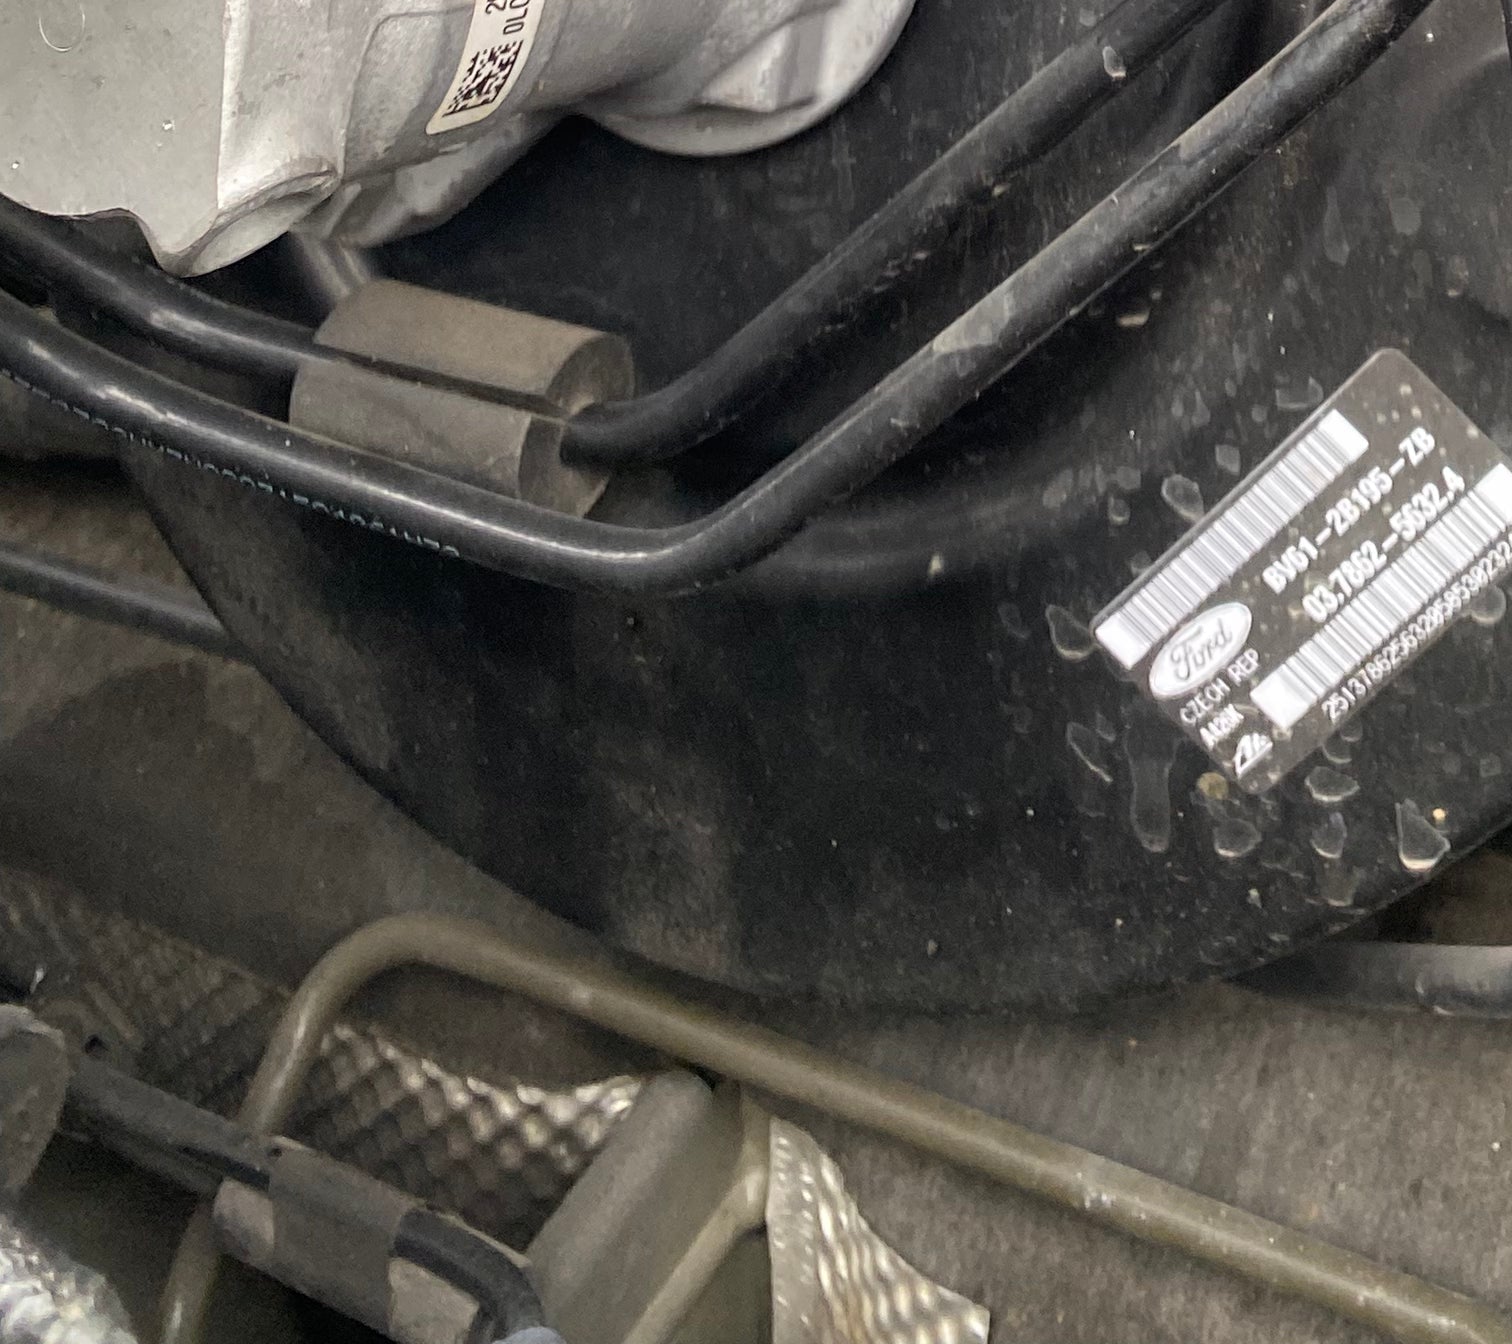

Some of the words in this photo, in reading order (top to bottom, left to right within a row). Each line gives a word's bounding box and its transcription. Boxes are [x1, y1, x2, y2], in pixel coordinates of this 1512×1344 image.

[1262, 426, 1436, 595] BV61-2B195-ZB
[1301, 465, 1466, 623] 03.7862-5632.4
[1179, 677, 1231, 727] CZECH
[1226, 647, 1260, 687] REP
